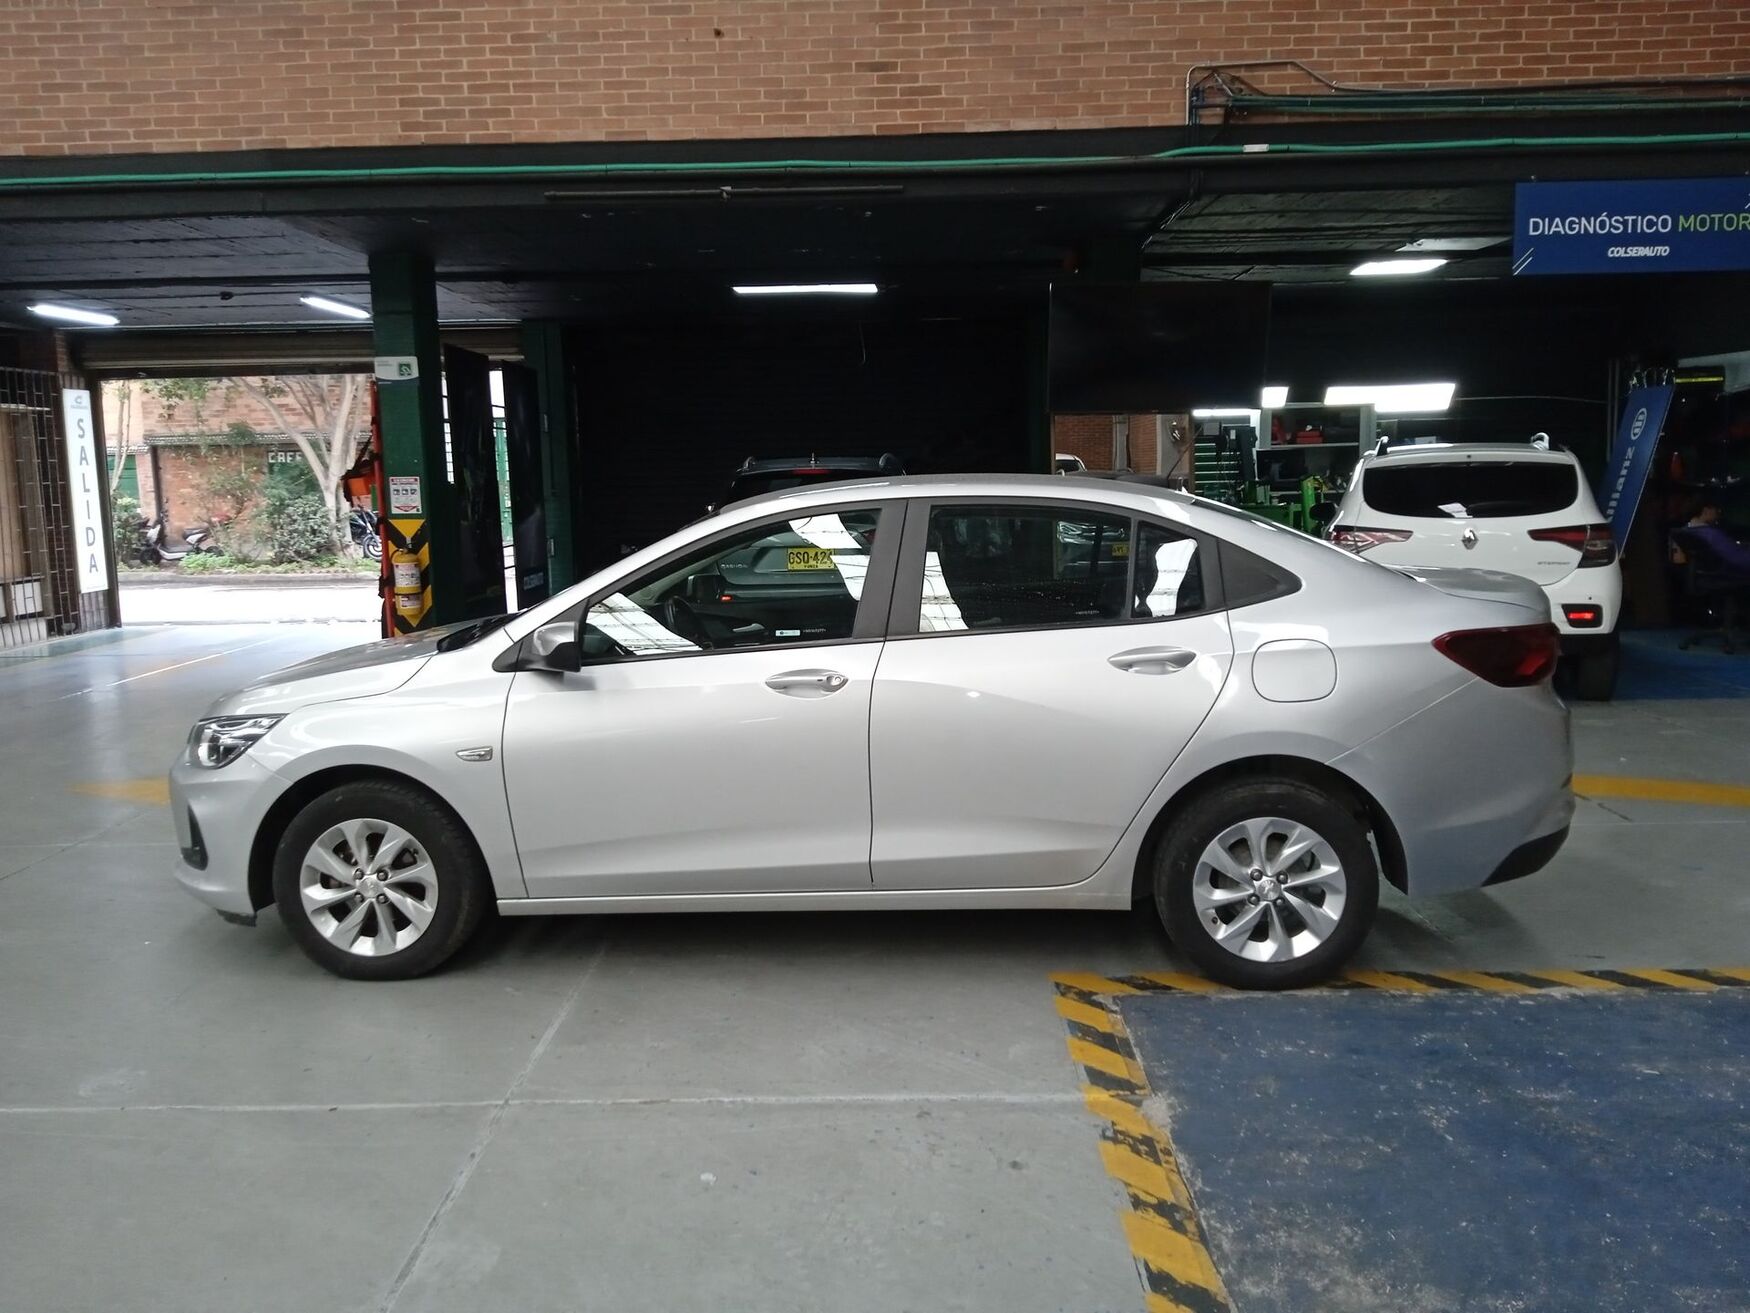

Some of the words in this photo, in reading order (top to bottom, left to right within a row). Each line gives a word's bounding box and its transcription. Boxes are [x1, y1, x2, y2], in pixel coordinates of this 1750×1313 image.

[1528, 212, 1672, 236] DIAGNÓSTICO
[1607, 245, 1670, 258] COLSERAUTO
[76, 417, 99, 574] SALIDA
